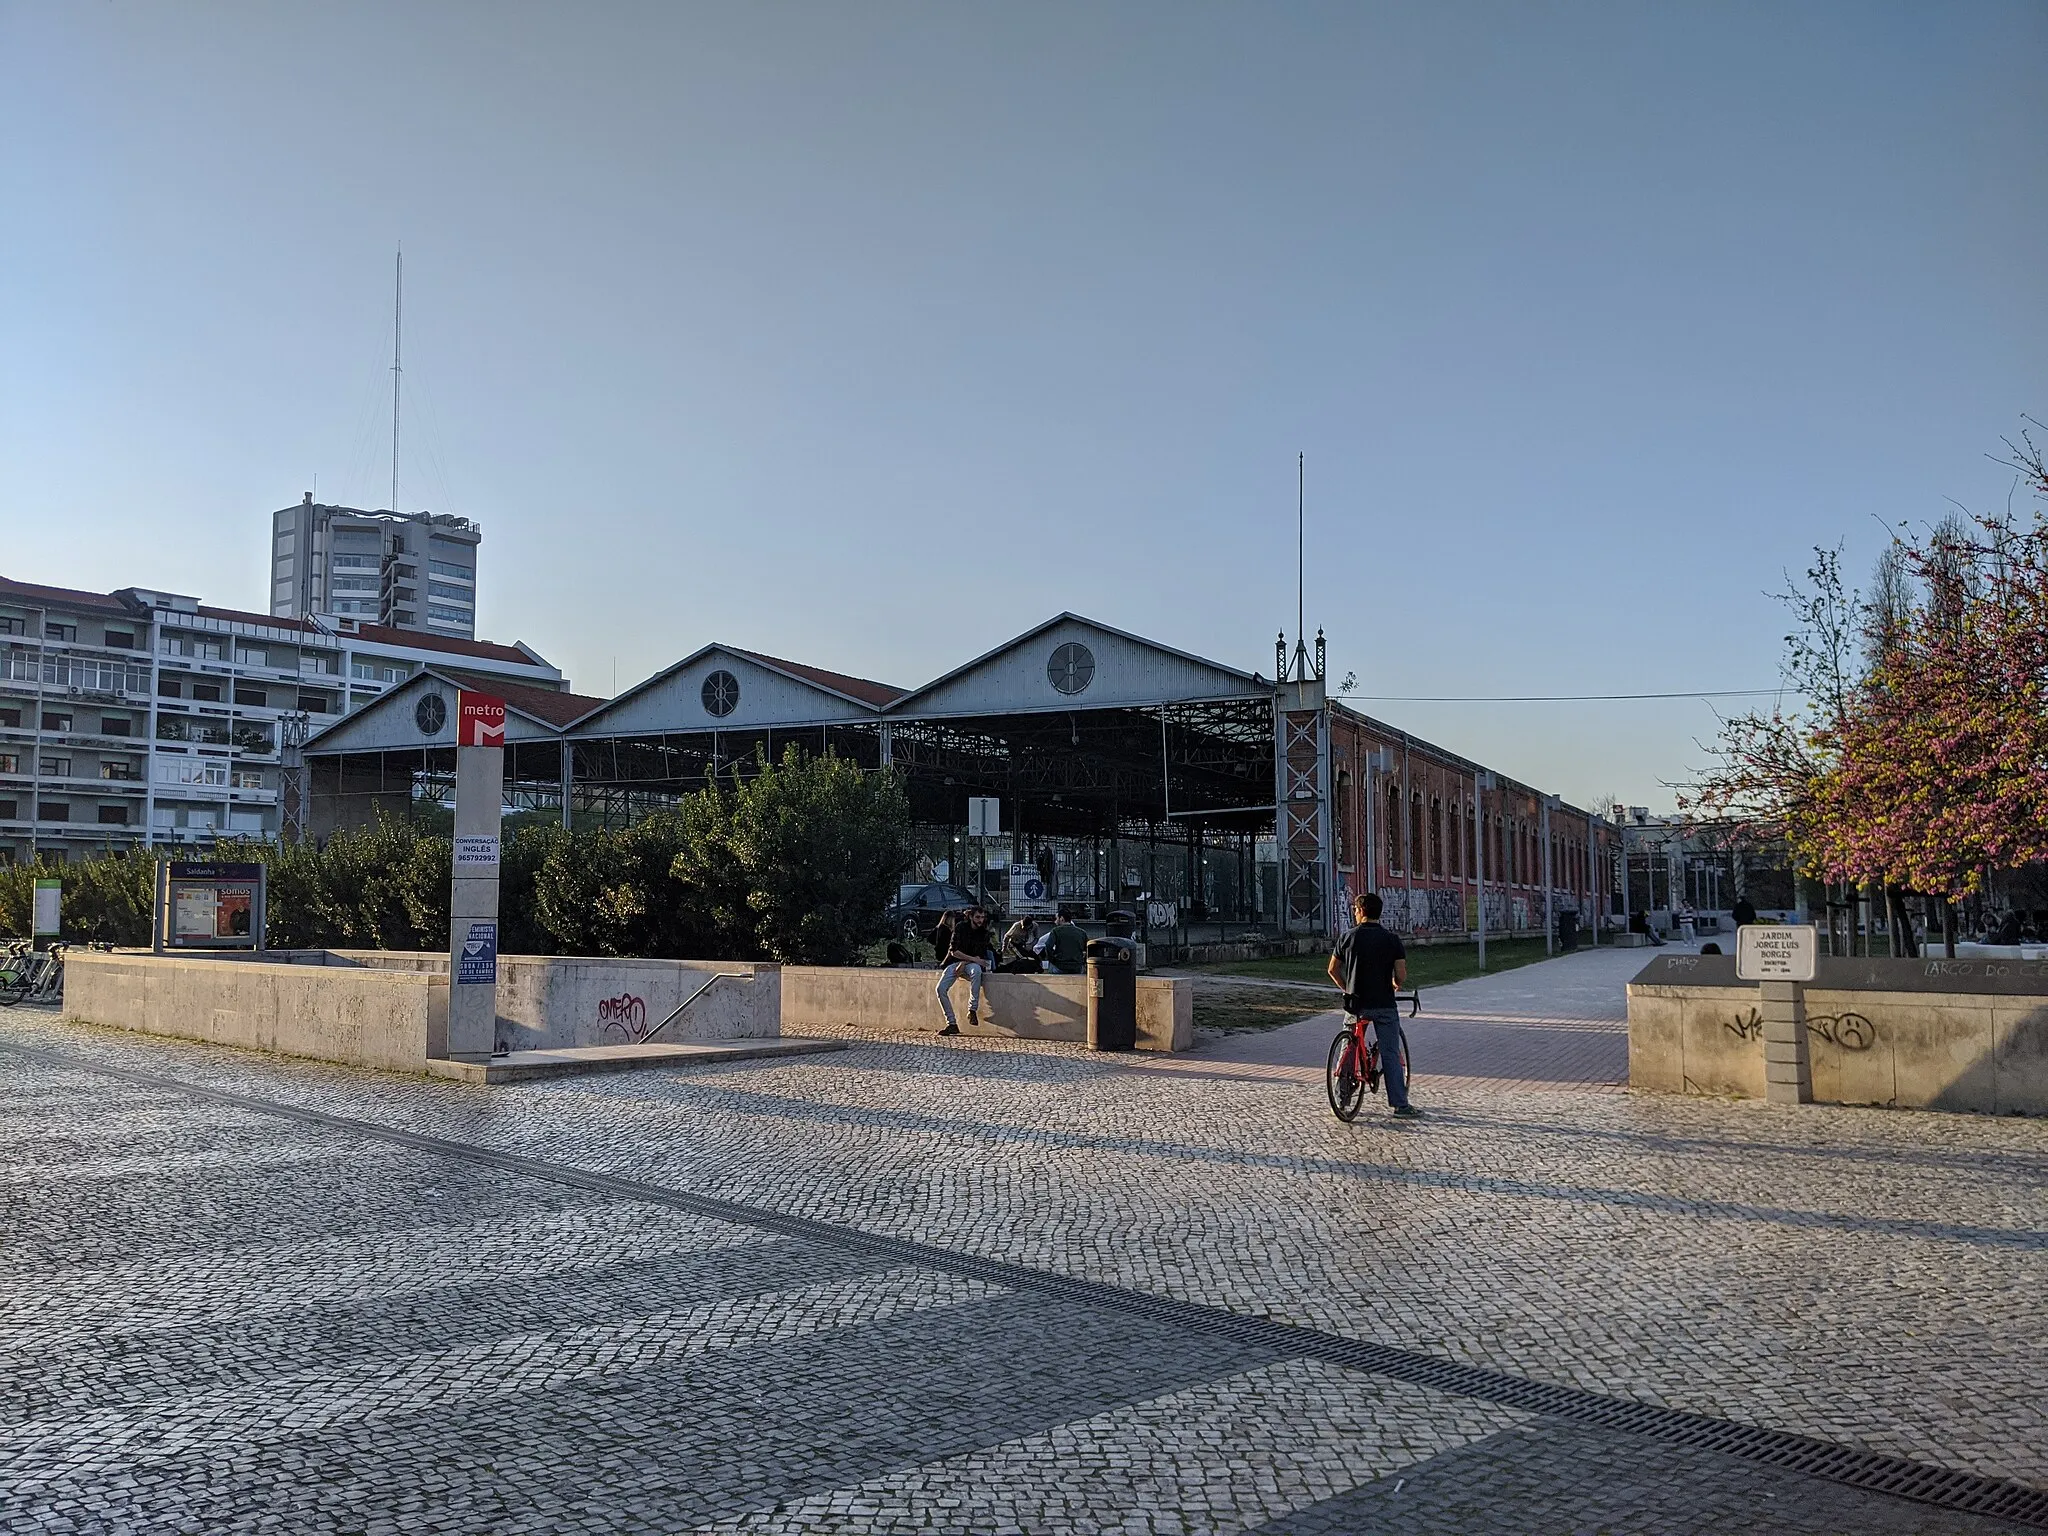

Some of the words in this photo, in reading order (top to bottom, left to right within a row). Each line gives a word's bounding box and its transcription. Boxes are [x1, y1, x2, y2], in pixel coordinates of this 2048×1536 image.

[464, 704, 504, 716] metro
[1760, 932, 1792, 940] JARDIM
[1754, 941, 1779, 949] JORGE
[1761, 950, 1791, 958] BORGES
[1985, 964, 2010, 977] DO
